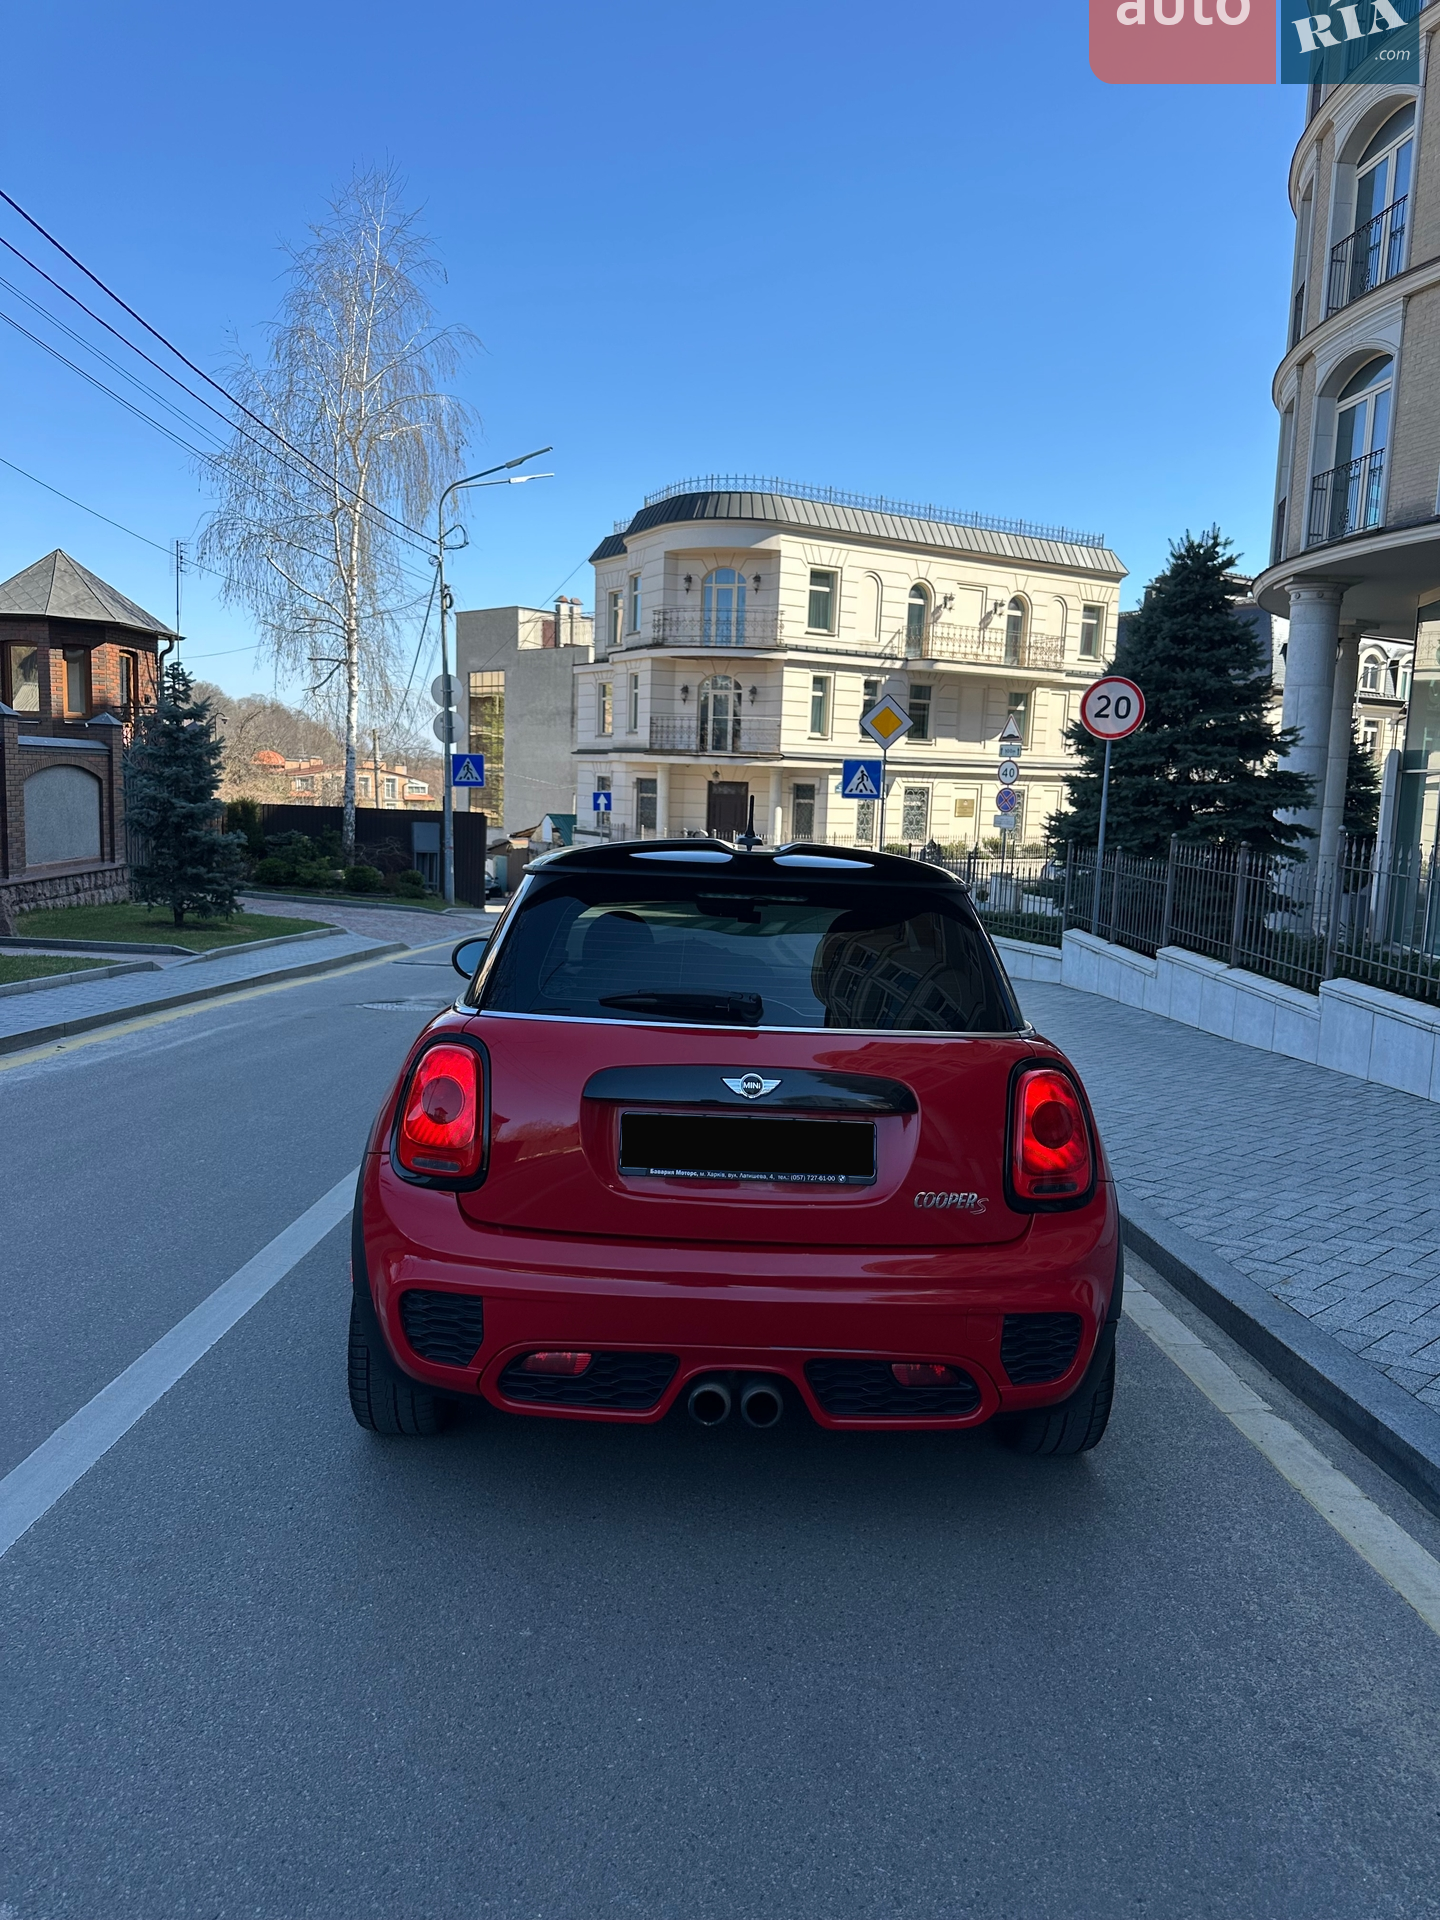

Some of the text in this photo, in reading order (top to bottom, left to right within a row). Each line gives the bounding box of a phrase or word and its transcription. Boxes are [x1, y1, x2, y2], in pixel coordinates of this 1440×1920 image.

[1093, 694, 1132, 719] 20
[1001, 767, 1015, 778] 40
[743, 1081, 761, 1090] MINI
[790, 1174, 806, 1182] (057)
[807, 1174, 836, 1182] 727-61-00
[913, 1191, 990, 1215] COOPER S
